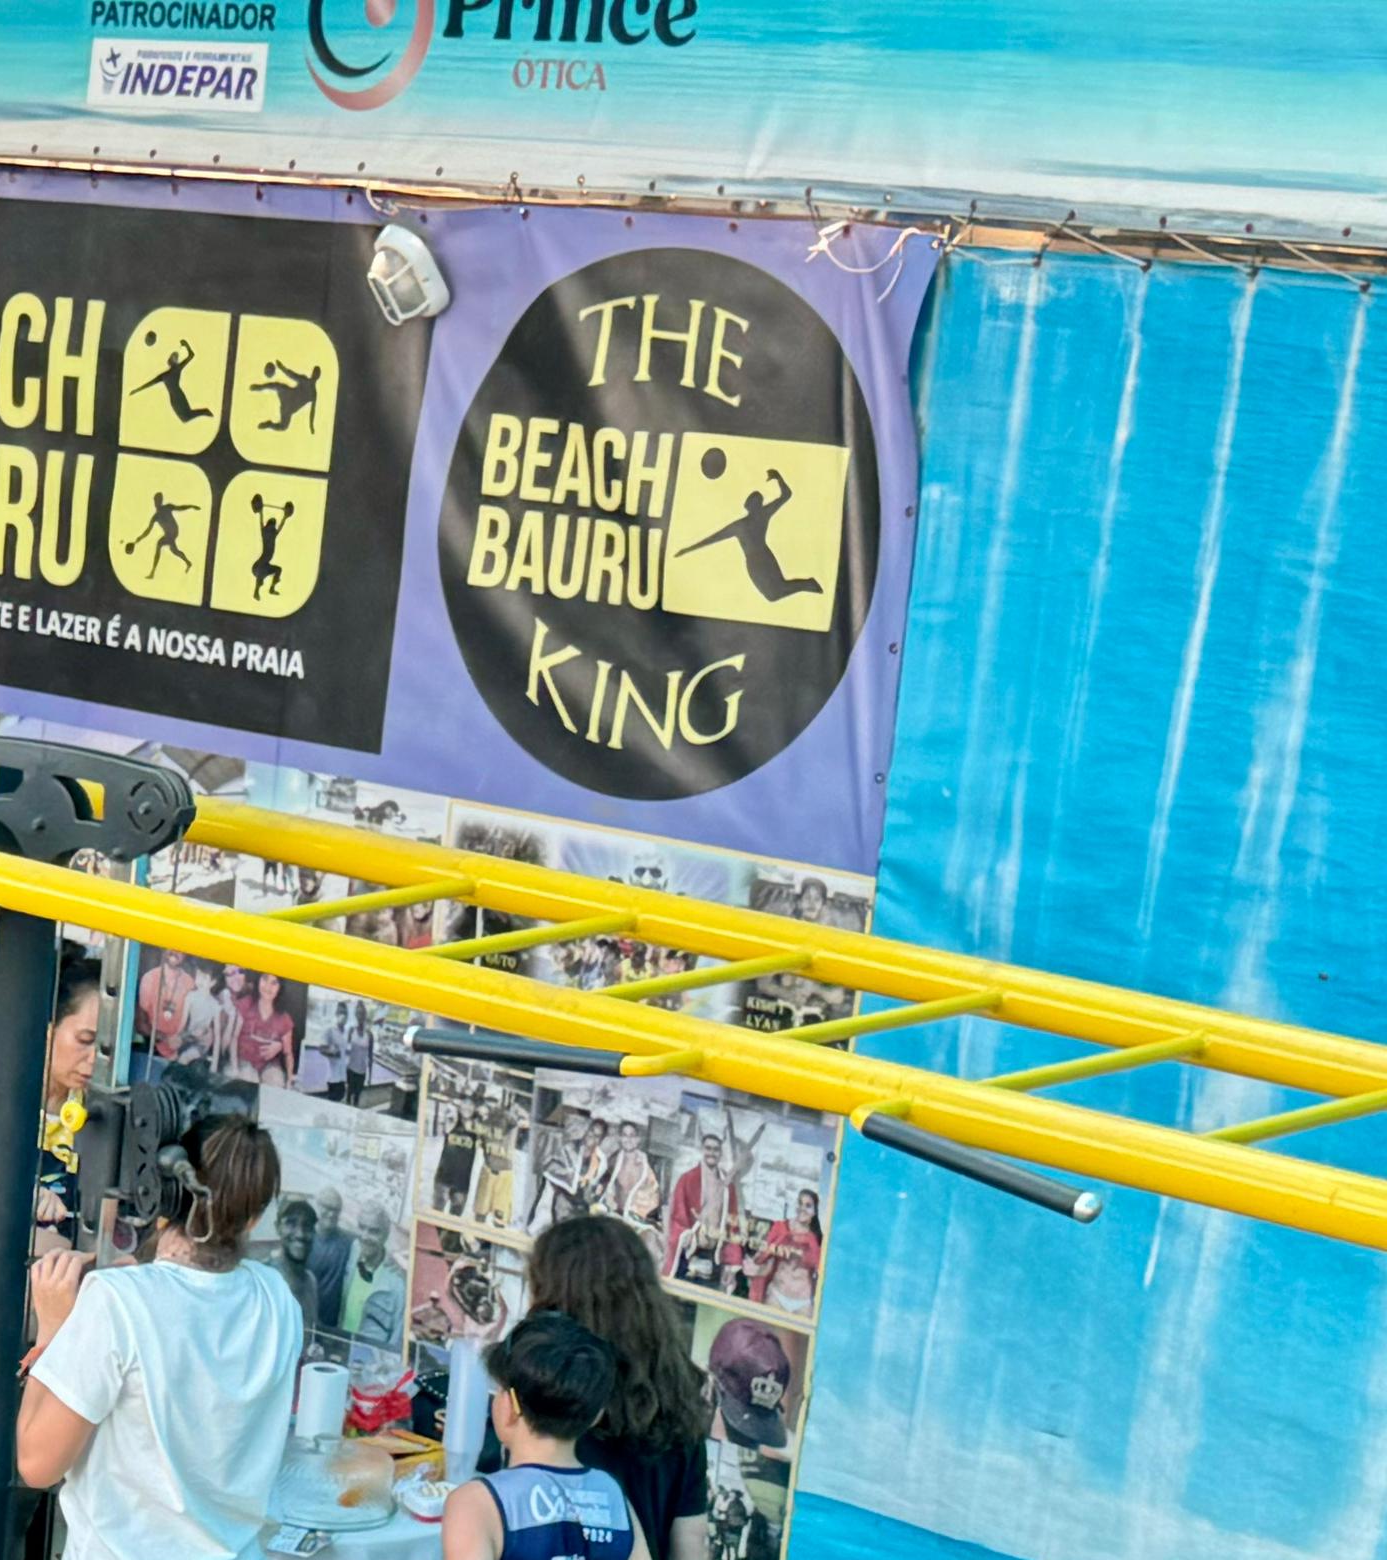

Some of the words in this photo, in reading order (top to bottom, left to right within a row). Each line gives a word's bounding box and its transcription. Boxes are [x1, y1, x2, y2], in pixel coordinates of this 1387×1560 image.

[91, 1, 276, 31] PATROCINADOR
[119, 62, 258, 100] INDEPAR
[511, 52, 607, 91] ÓTICA
[578, 293, 749, 407] THE
[481, 412, 674, 518] BEACH
[467, 504, 663, 611] BAURU
[17, 604, 31, 632] E
[35, 611, 100, 645] LAZER
[106, 613, 121, 648] É
[124, 623, 142, 652] A
[147, 627, 226, 667] NOSSA
[231, 640, 305, 680] PRAIA
[525, 616, 747, 750] KING
